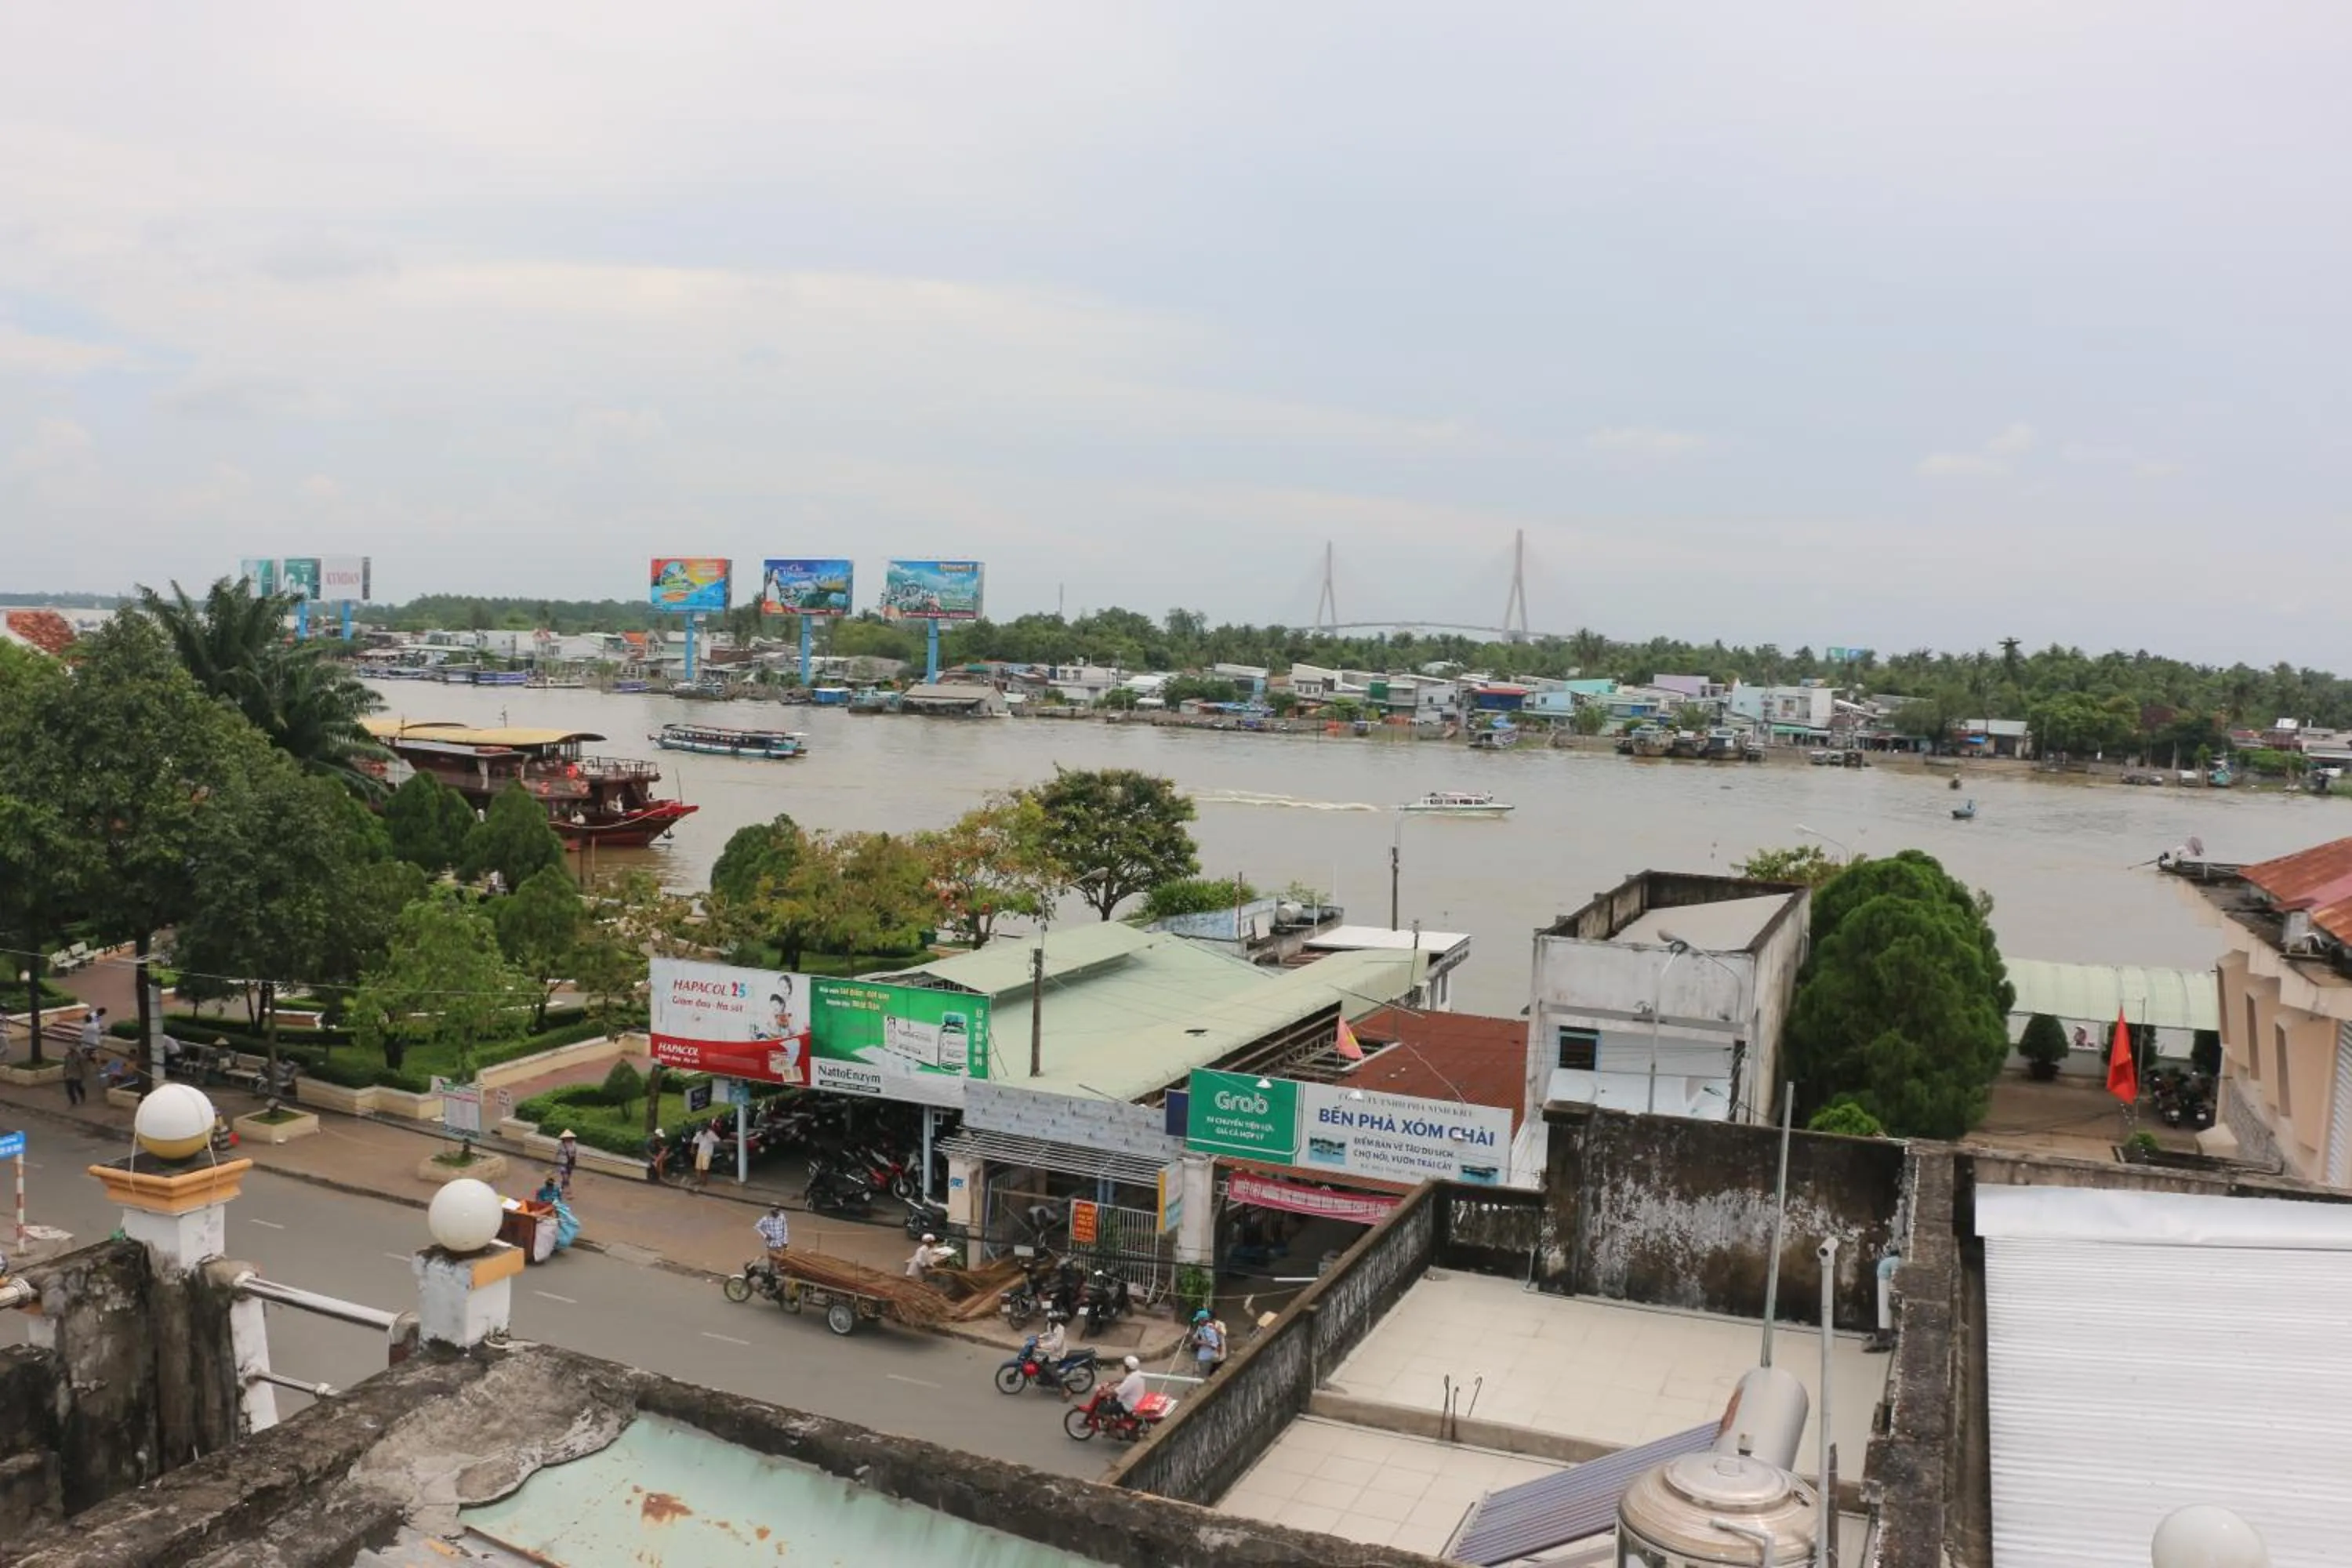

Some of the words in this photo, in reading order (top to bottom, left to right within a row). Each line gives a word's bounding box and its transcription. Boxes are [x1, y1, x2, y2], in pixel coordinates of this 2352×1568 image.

[673, 979, 728, 996] HAPACOL
[731, 982, 746, 998] 25
[658, 1042, 700, 1056] HAPACOL
[818, 1065, 880, 1084] NattoEnzym
[1214, 1091, 1269, 1114] Grab
[1319, 1105, 1354, 1127] BẾN
[1402, 1117, 1443, 1138] XÓM
